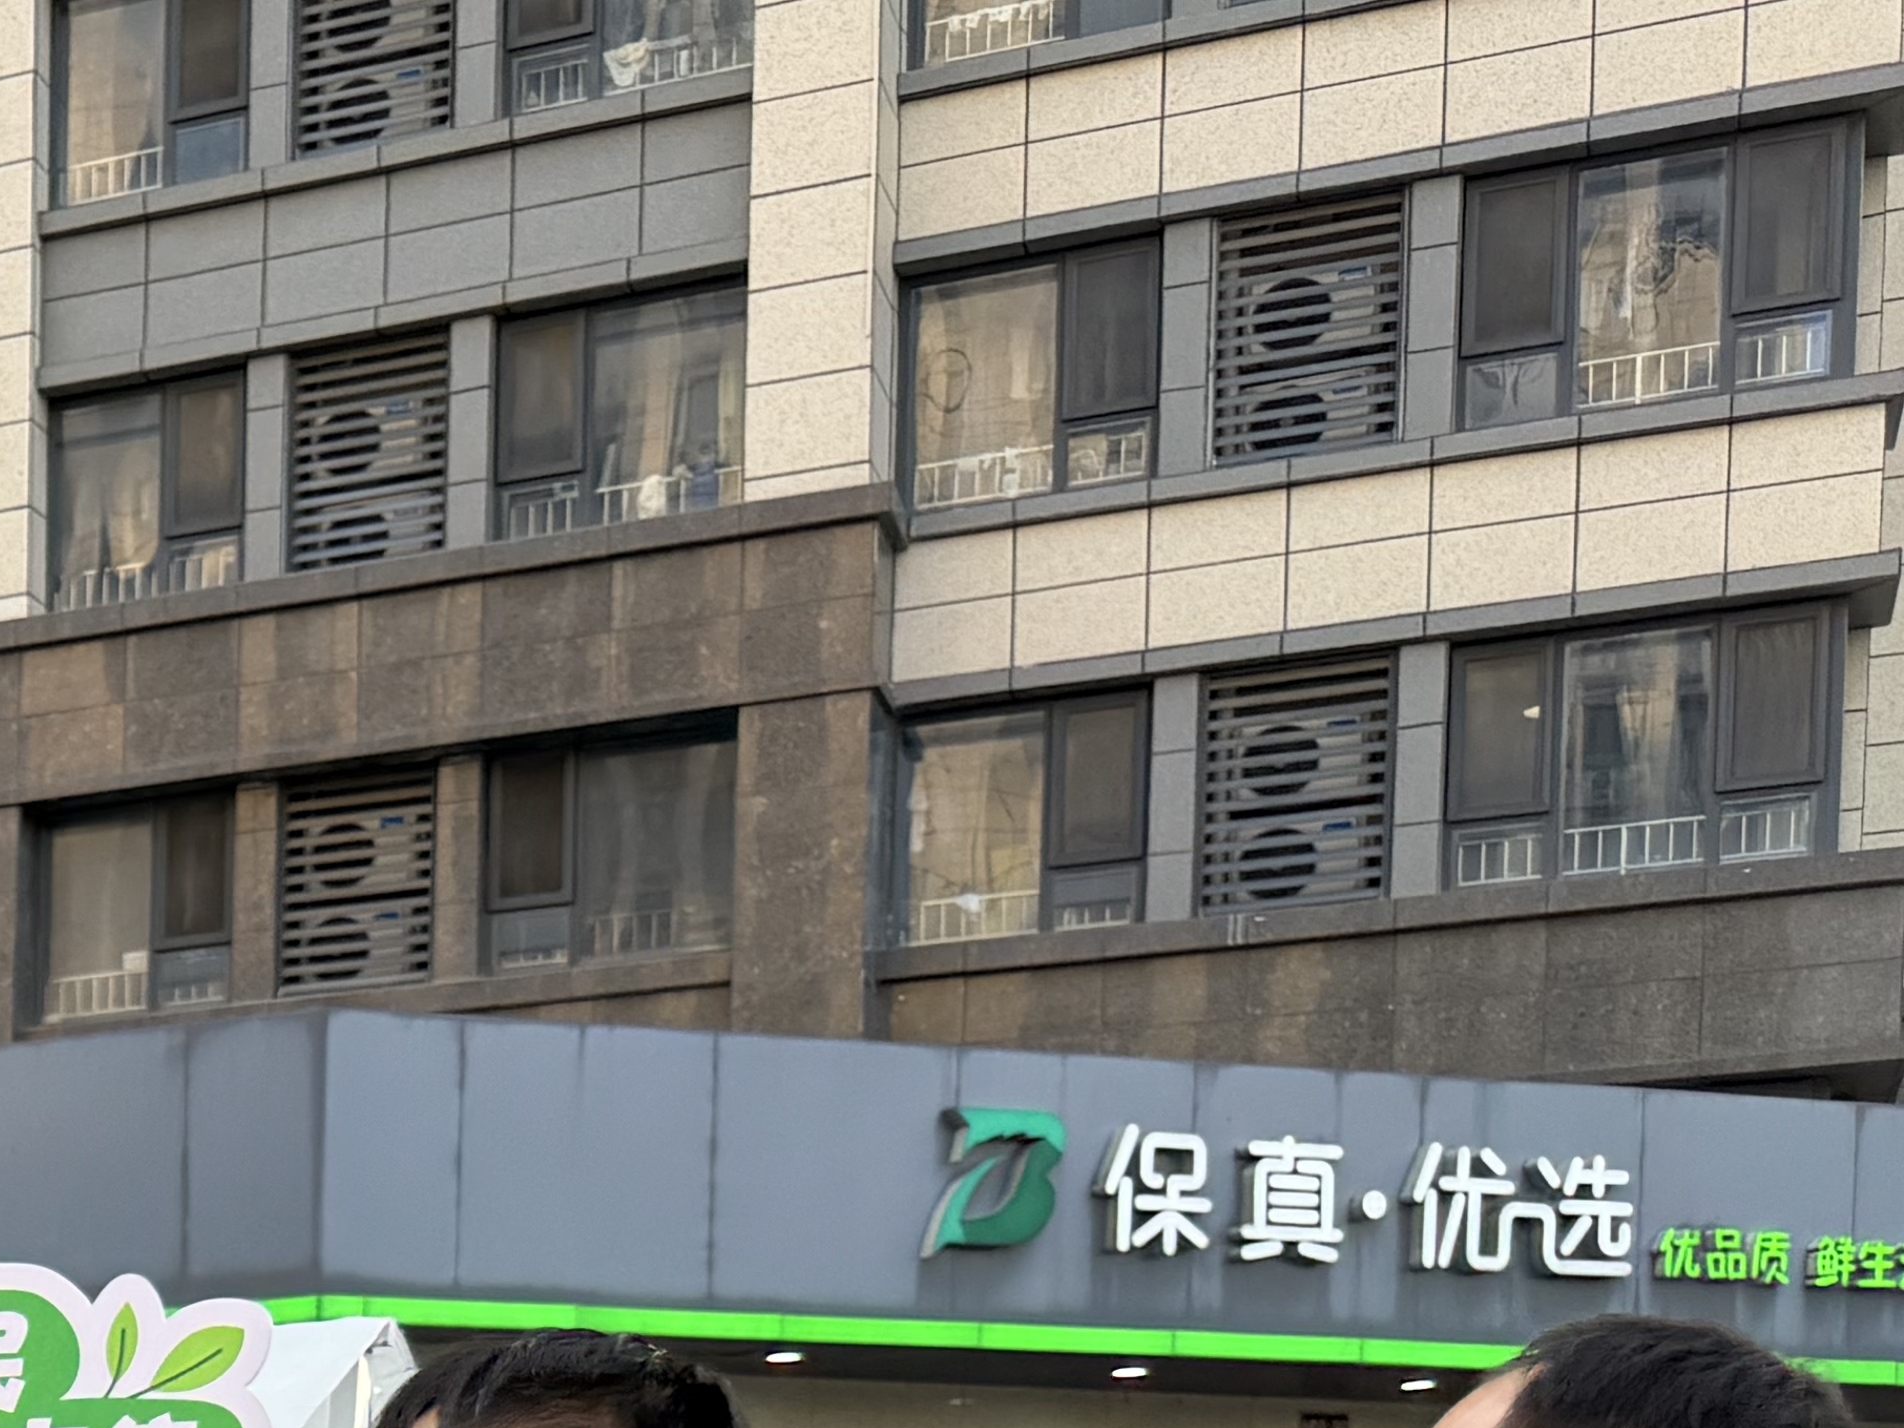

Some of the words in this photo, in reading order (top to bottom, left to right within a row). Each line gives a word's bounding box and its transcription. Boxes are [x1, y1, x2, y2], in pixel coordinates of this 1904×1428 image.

[1100, 1121, 1636, 1281] 保真·优选
[1655, 1228, 1792, 1286] 优品质
[1808, 1234, 1904, 1290] 鲜生
